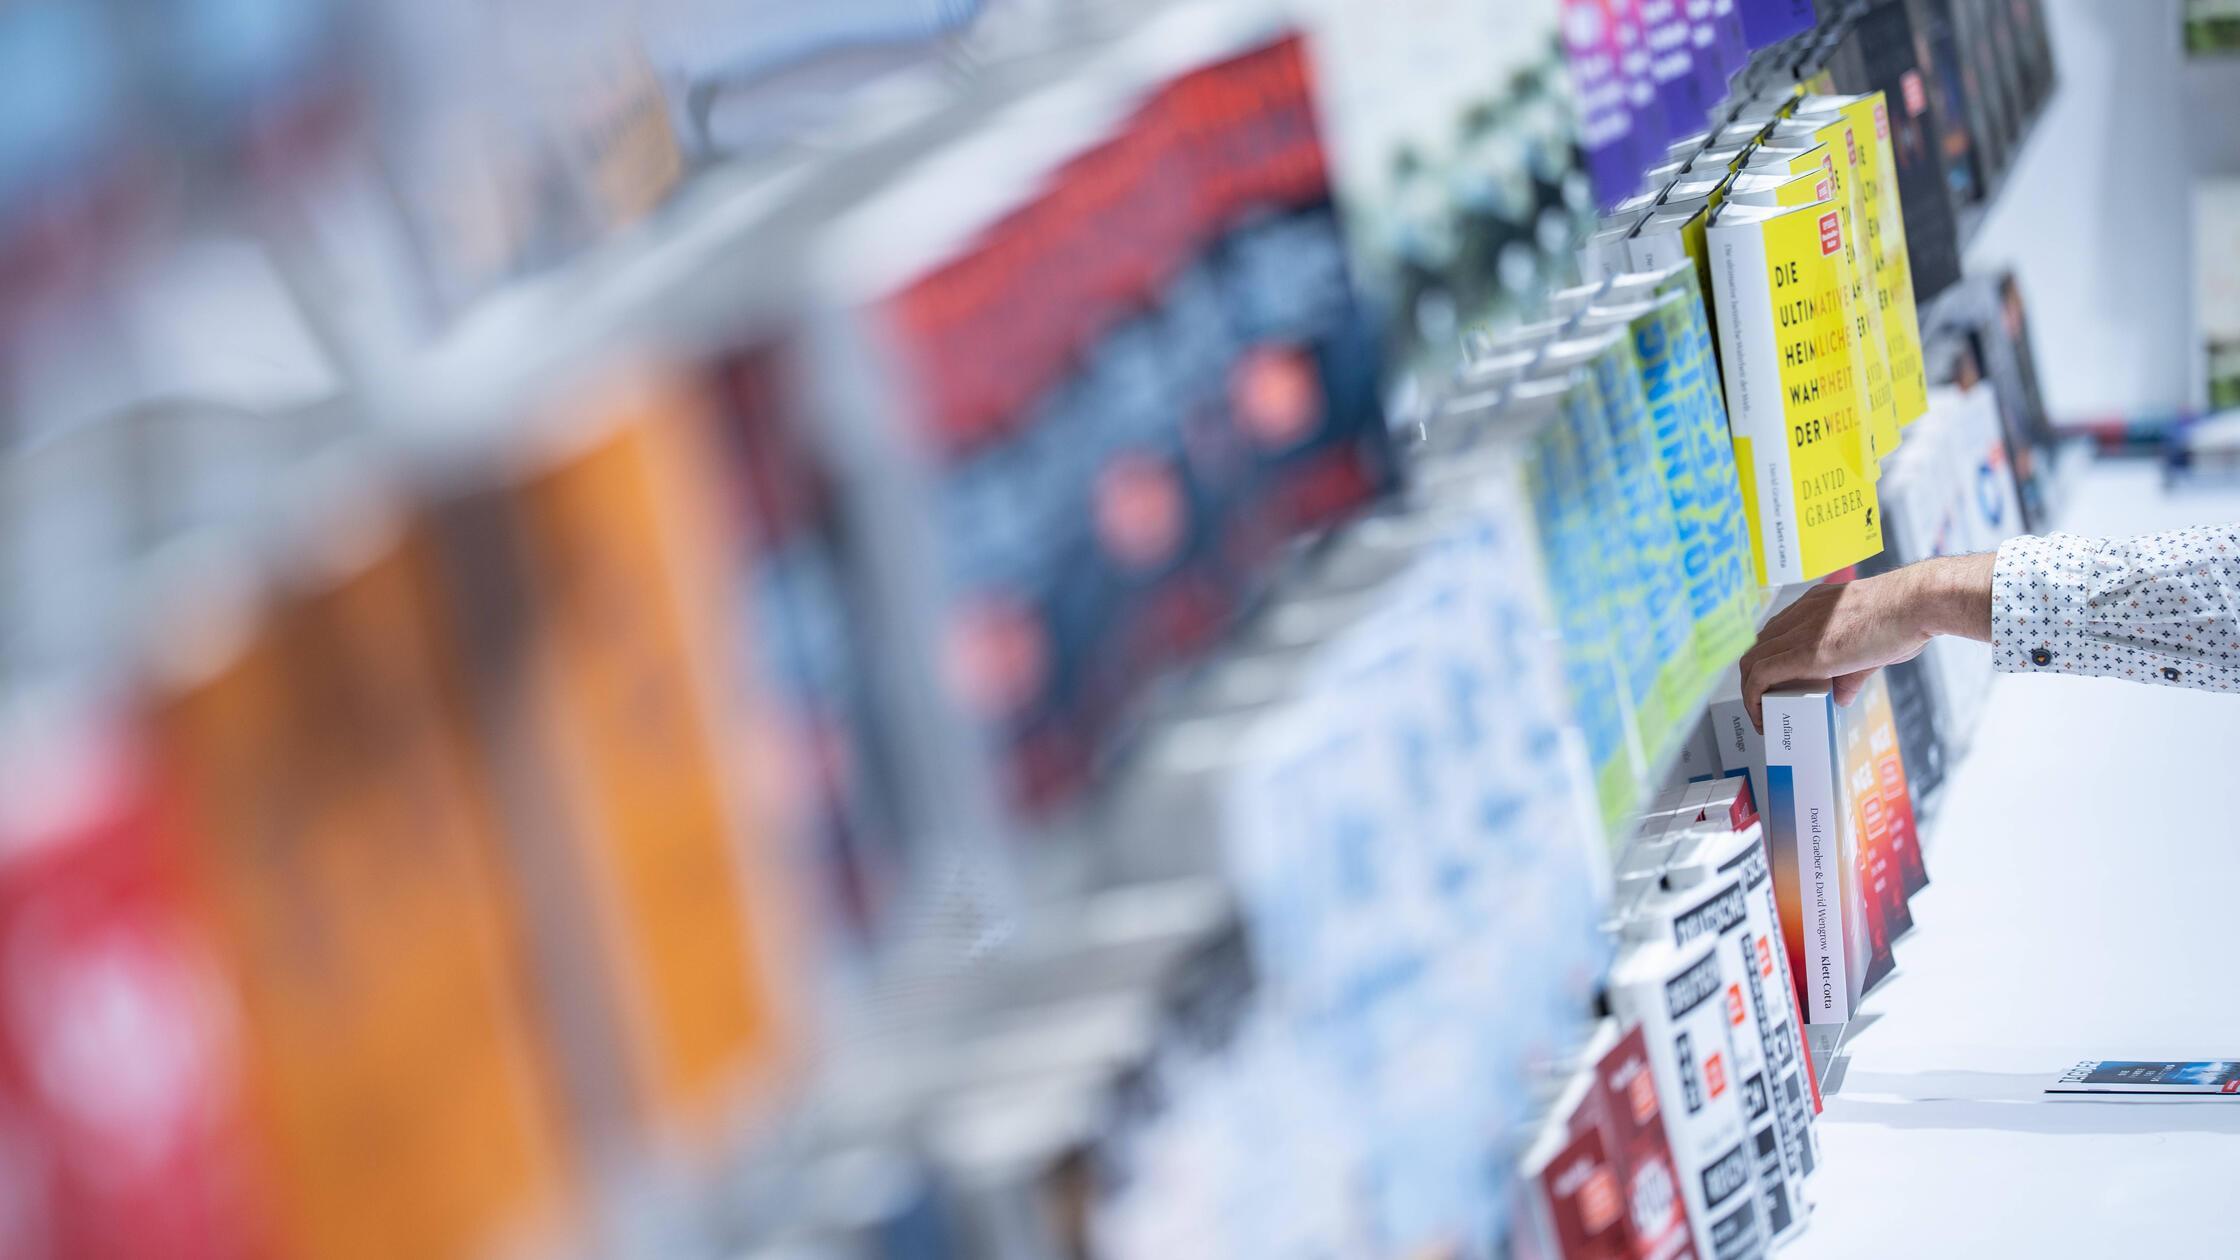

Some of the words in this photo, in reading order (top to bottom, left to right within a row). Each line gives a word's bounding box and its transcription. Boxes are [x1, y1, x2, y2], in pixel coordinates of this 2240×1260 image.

[1775, 261, 1798, 288] DIE
[1780, 285, 1849, 328] ULTIMATIVE
[1785, 325, 1852, 367] HEIMLICHE
[1789, 366, 1853, 407] WAHRHEIT
[1795, 419, 1821, 448] DER
[1637, 319, 1718, 619] HOFFNUNG
[1672, 329, 1742, 598] SKEPSIS
[1802, 468, 1845, 500] DAVID
[1805, 490, 1864, 527] GRAEBER
[1732, 715, 1745, 753] Anfänge
[1782, 713, 1792, 751] Anfänge
[1810, 808, 1821, 834] David
[1812, 836, 1825, 870] Graeber
[1815, 871, 1824, 880] &
[1815, 882, 1827, 908] David
[1816, 909, 1828, 951] Wengrow
[1821, 956, 1832, 1009] Klett-Cotta
